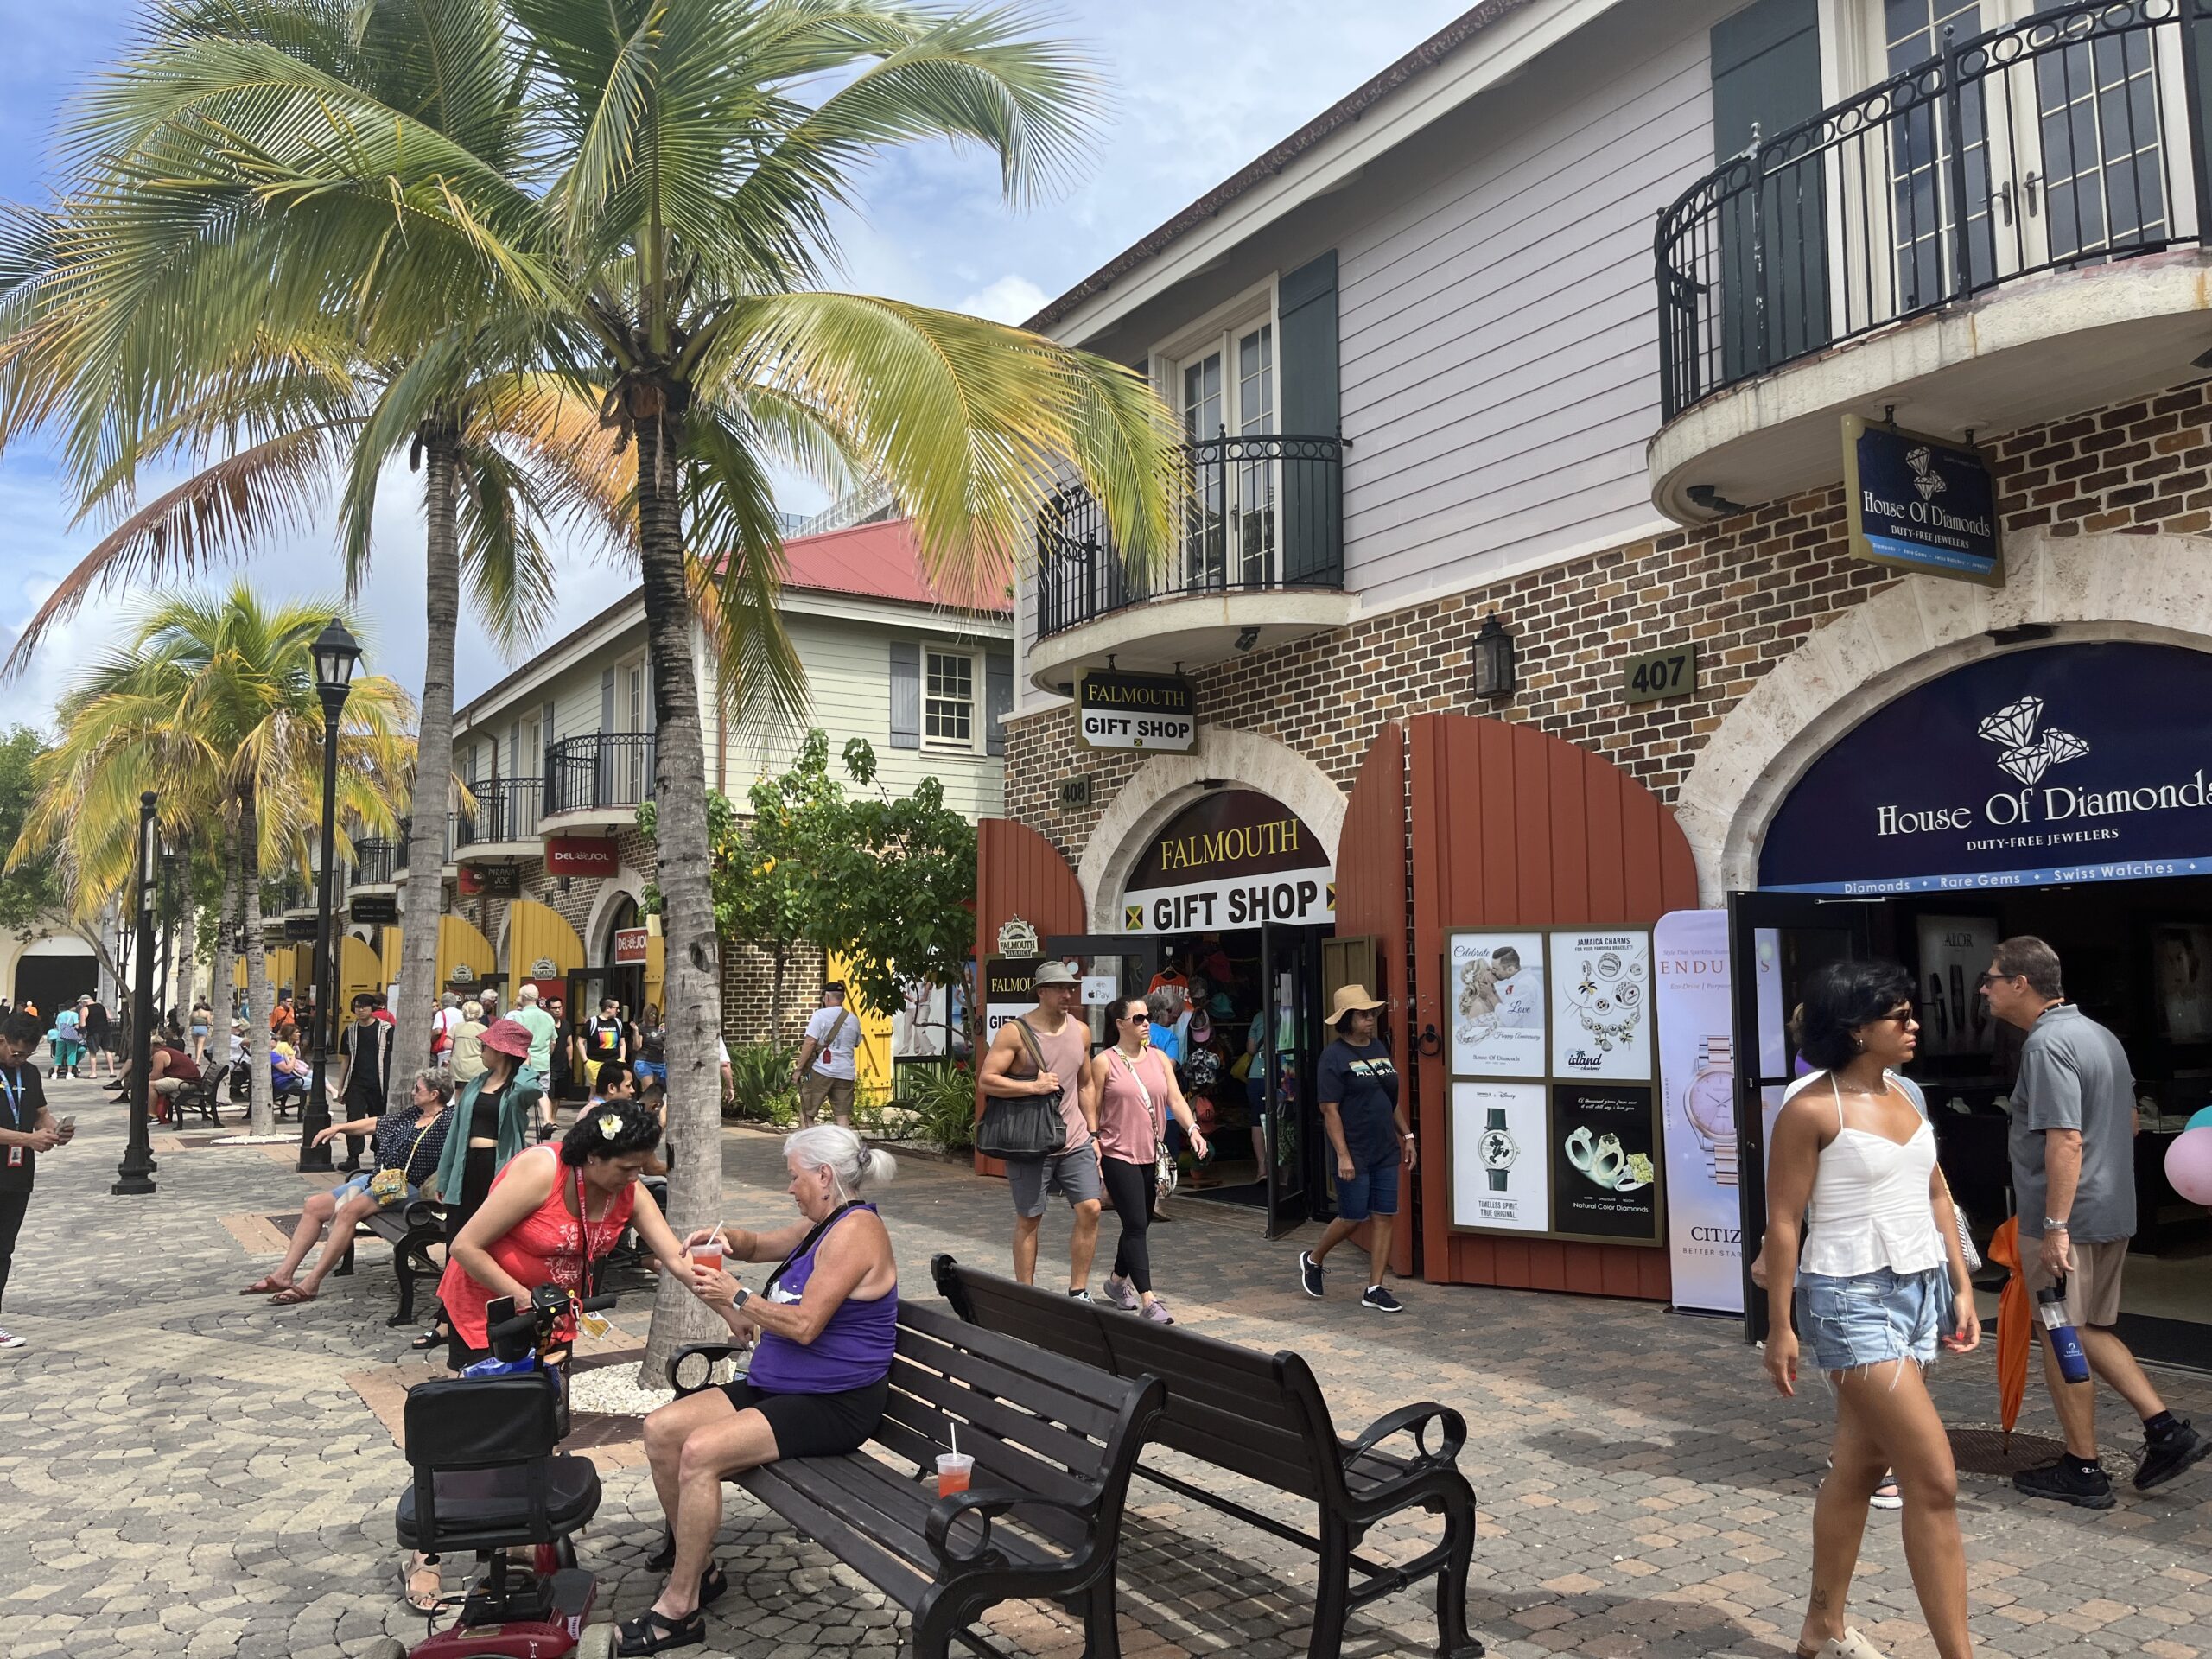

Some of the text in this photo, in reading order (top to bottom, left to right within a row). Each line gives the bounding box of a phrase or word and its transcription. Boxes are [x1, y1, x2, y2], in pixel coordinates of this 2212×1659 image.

[1864, 490, 1991, 537] House Of Diamonds
[1891, 524, 1969, 549] DUTY-FREE JEWELERS
[1631, 655, 1686, 693] 407
[1087, 684, 1185, 708] FALMOUTH
[1084, 716, 1190, 739] GIFT SHOP
[1063, 781, 1085, 803] 408
[1877, 805, 1973, 836] House
[1986, 787, 2033, 825] Of
[1160, 818, 1300, 872] FALMOUTH
[1967, 827, 2120, 852] DUTY-FREE JEWELERS
[588, 852, 609, 861] SOL
[495, 876, 510, 885] JOE
[1844, 861, 2175, 894] Diamonds Rare Gems Swiss Watches
[1153, 880, 1319, 931] GIFT SHOP
[618, 936, 628, 951] DEL
[1000, 940, 1035, 950] FALMOUTH
[1578, 937, 1630, 946] JAMAICA CHARMS
[1942, 932, 1974, 948] ALOR
[1453, 945, 1491, 958] Celebrate
[991, 977, 1038, 993] FALMOU
[1096, 989, 1110, 1001] Pay
[1507, 999, 1531, 1014] Love
[989, 1014, 1017, 1029] GIF
[1568, 1052, 1603, 1065] island
[1498, 1090, 1516, 1100] Disney
[1478, 1199, 1501, 1209] TIMELESS
[1597, 1203, 1615, 1211] Color
[1616, 1204, 1649, 1213] Diamonds
[1480, 1209, 1493, 1217] TRUE
[1690, 1226, 1742, 1244] CITIZ
[1682, 1247, 1715, 1256] BETTER
